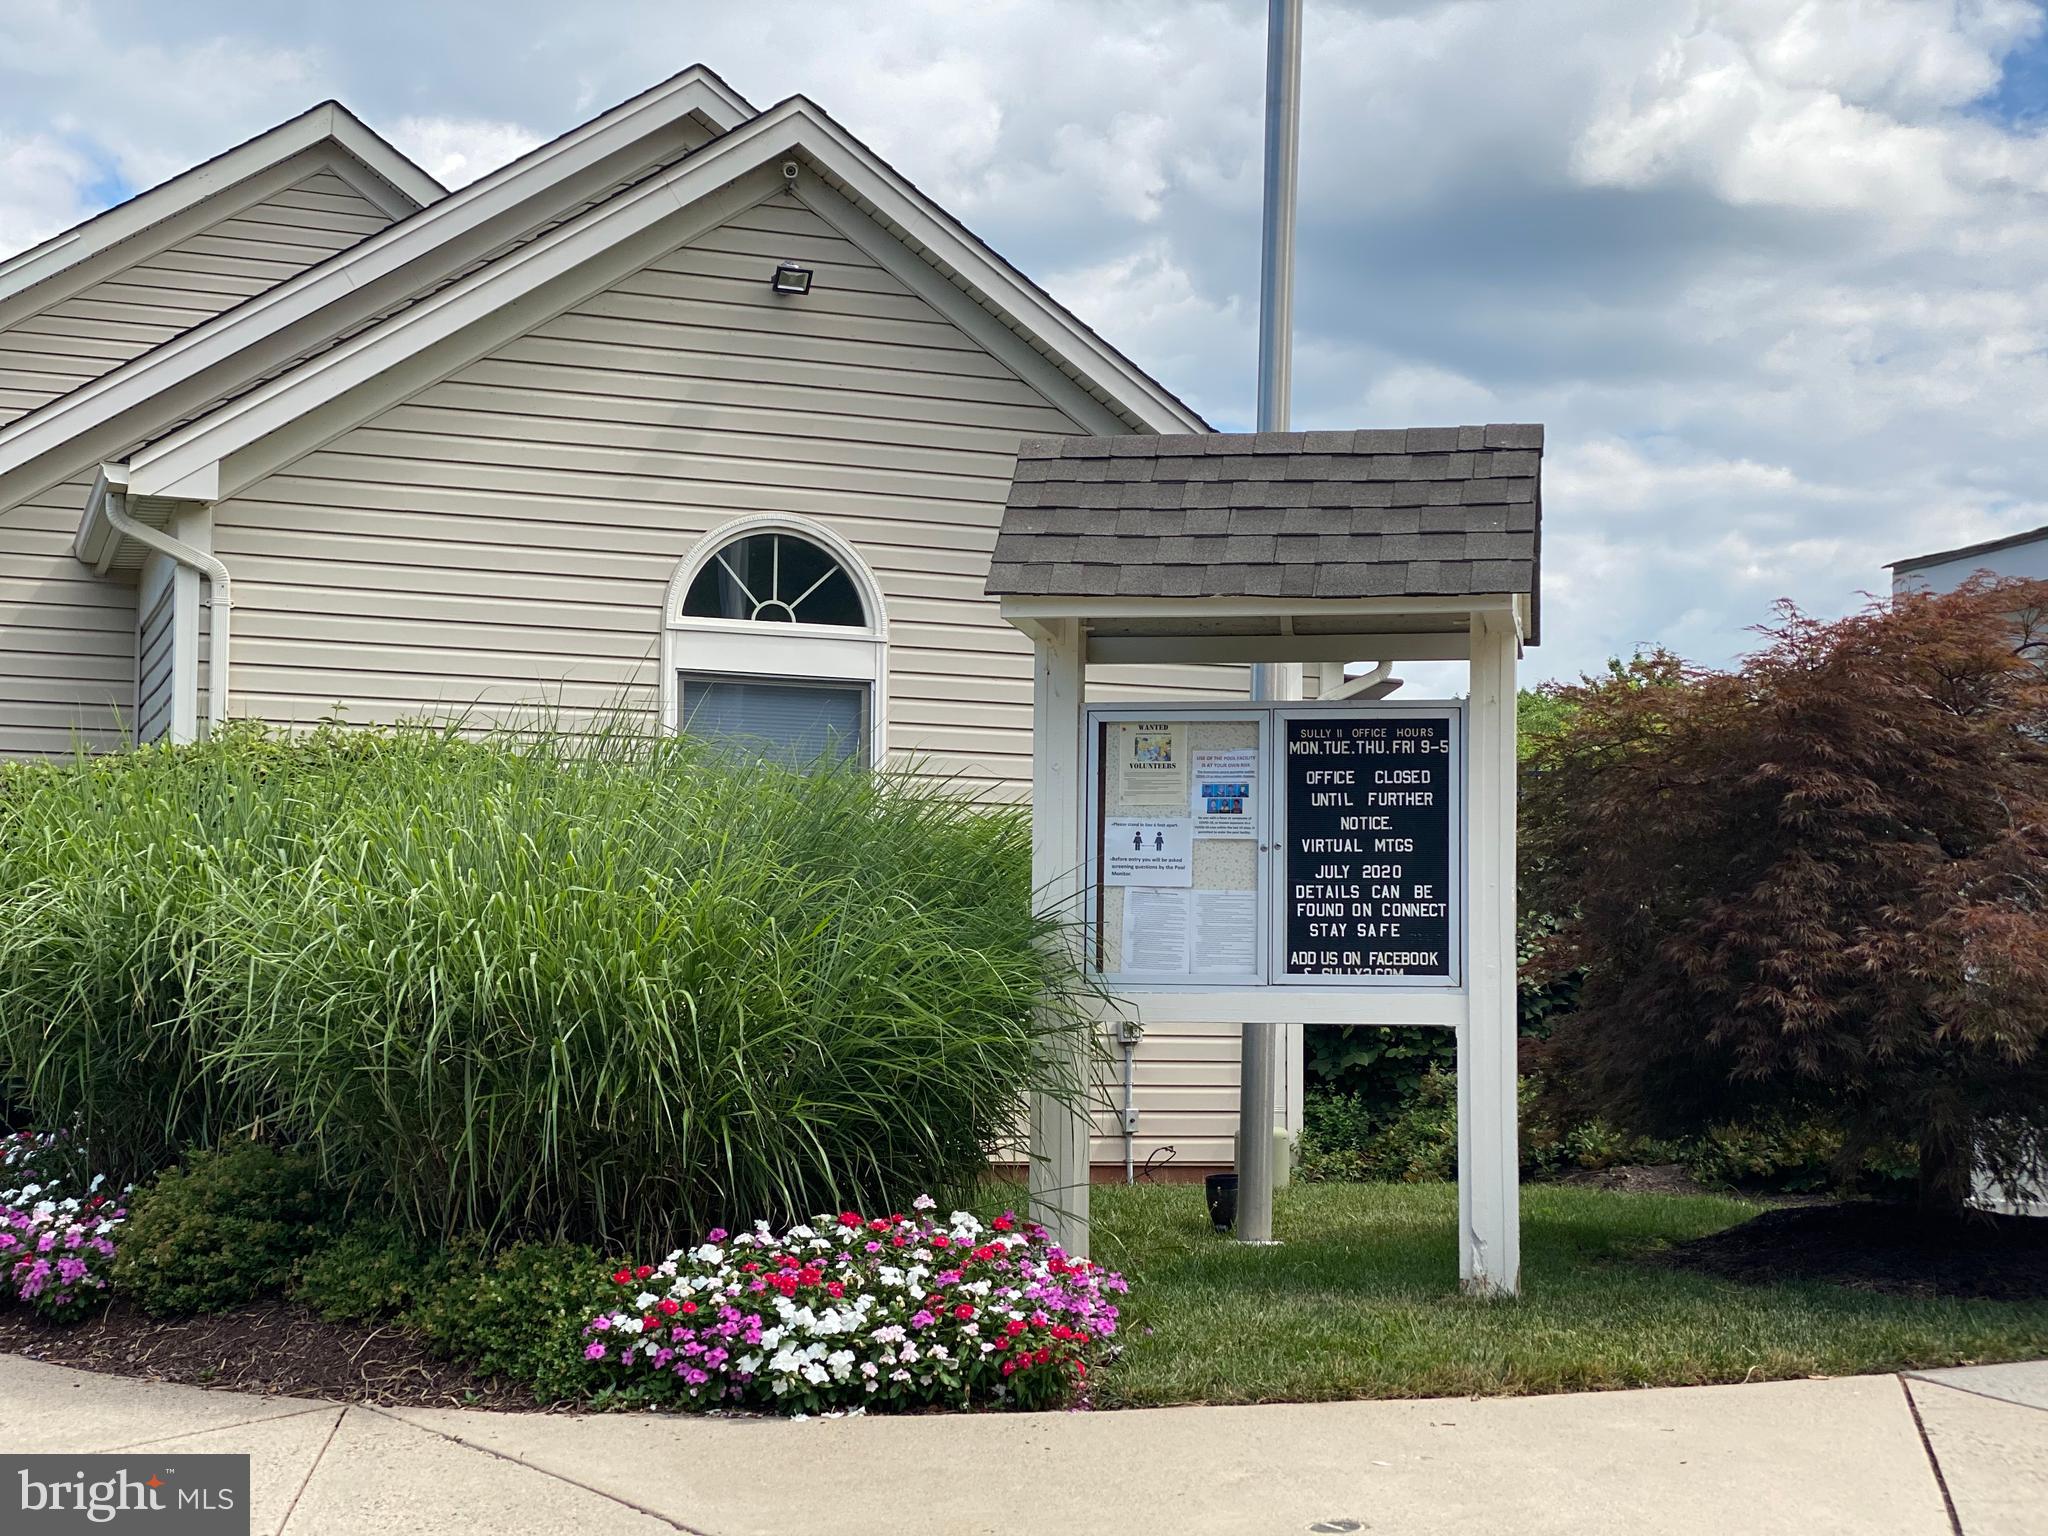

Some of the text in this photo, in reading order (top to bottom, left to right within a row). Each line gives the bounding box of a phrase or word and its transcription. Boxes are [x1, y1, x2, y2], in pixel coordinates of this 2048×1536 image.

[1301, 729, 1331, 738] SULLY
[1352, 728, 1387, 738] OFFICE
[1396, 728, 1434, 737] HOURS
[1420, 740, 1449, 753] 9-5
[1129, 762, 1176, 770] VOLUNTEERS
[1306, 770, 1431, 785] OFFICE CLOSED
[1312, 792, 1433, 806] UNTIL FURTHER
[1340, 816, 1393, 830] NOTICE.
[1301, 839, 1414, 853] VIRTUAL MTGS
[1315, 865, 1402, 879] JULY 2020
[1296, 885, 1433, 899] DETAILS CAN BE
[1297, 903, 1446, 917] FOUND ON CONNECT
[1309, 923, 1400, 937] STAY SAFE
[1290, 951, 1438, 966] ADD US ON FACEBOOK
